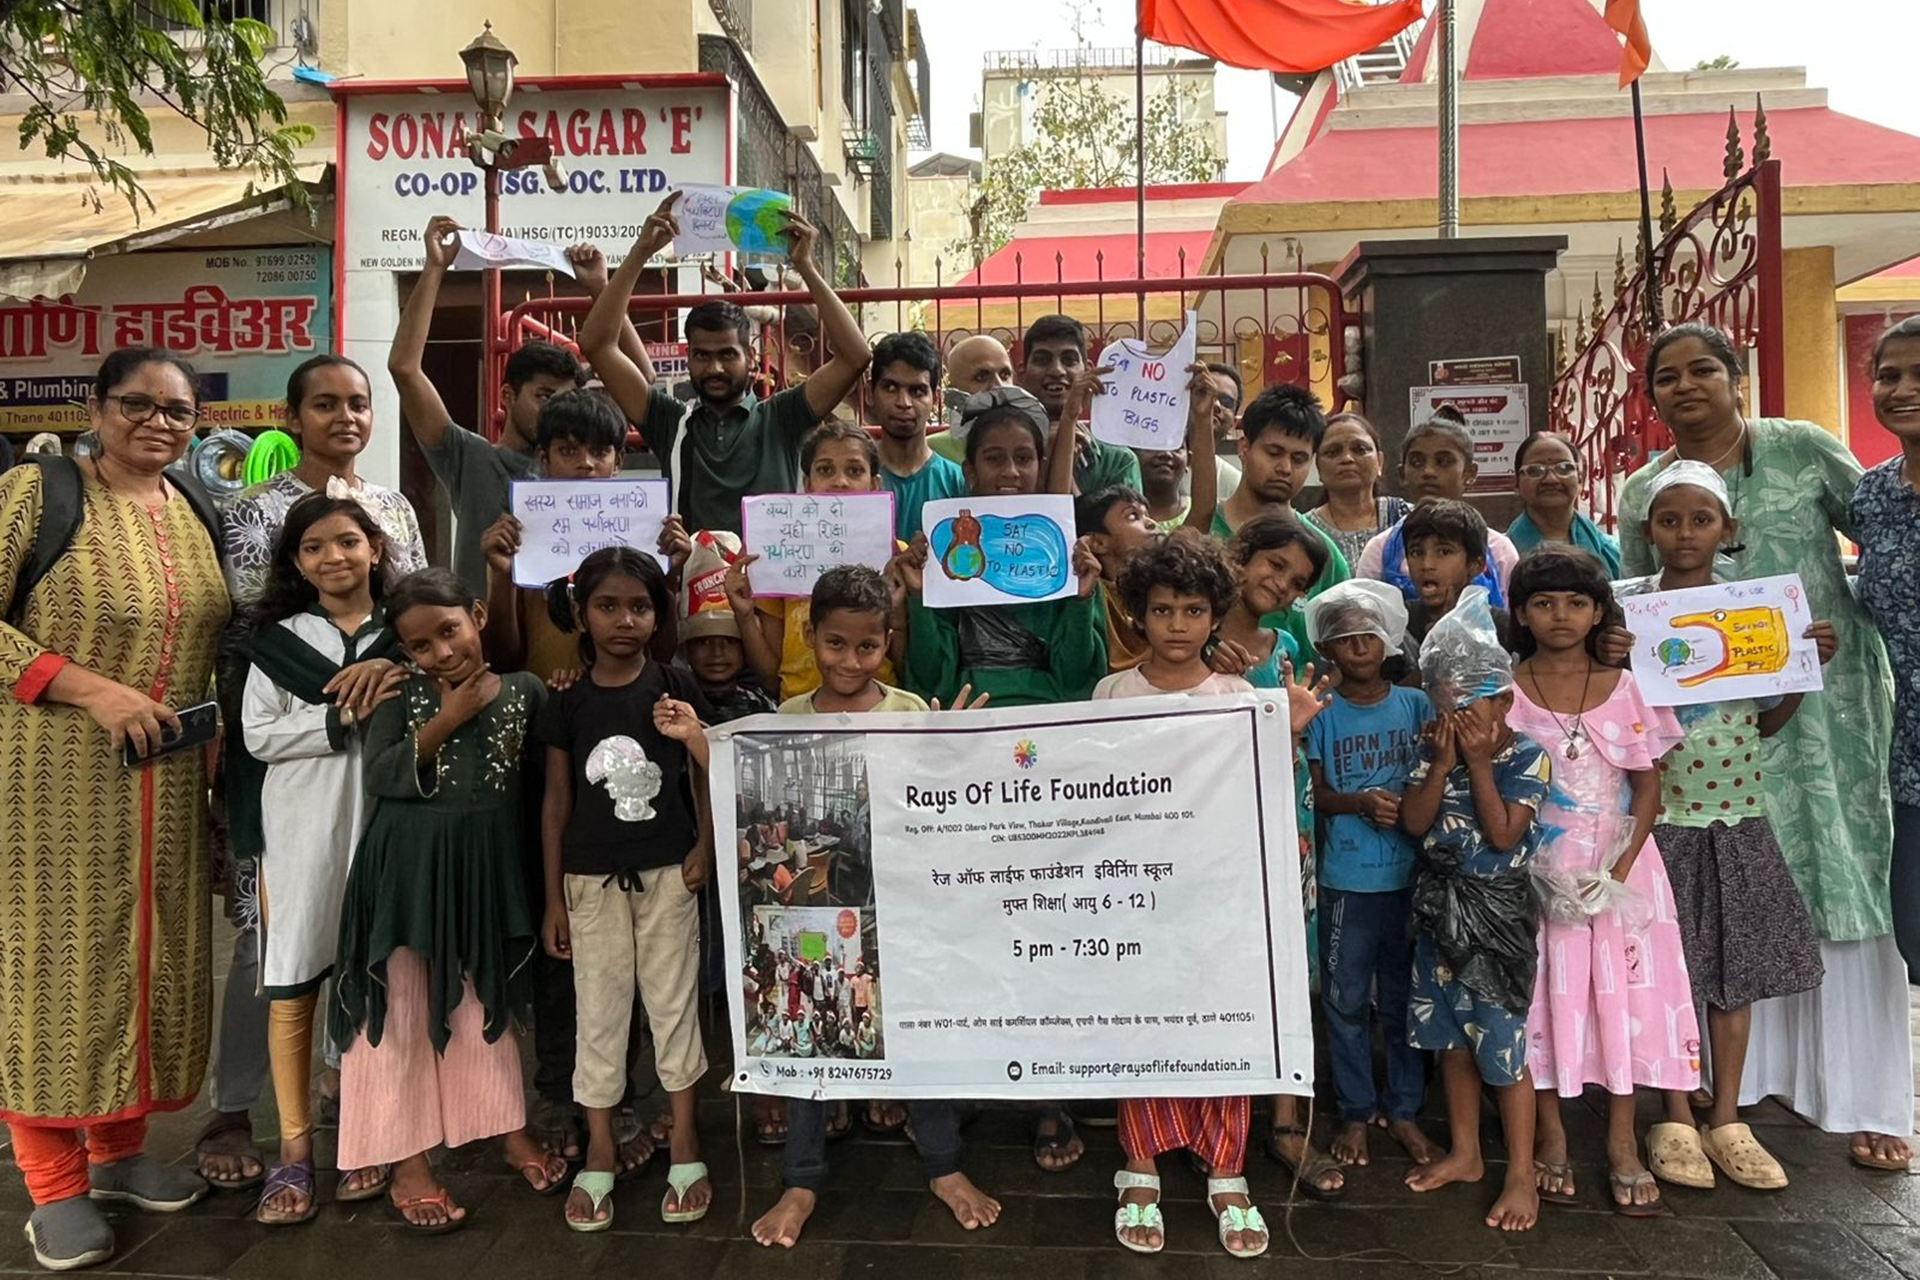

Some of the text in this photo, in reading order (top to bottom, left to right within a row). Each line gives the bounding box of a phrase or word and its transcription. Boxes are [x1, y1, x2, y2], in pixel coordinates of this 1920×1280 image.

[518, 108, 646, 156] SAGAR
[395, 171, 477, 196] CO-OP
[619, 168, 672, 192] LTD.
[382, 229, 421, 241] REGN.
[206, 257, 229, 268] MOB
[256, 255, 285, 266] 97699
[361, 259, 377, 267] NEW
[380, 257, 413, 267] GOLDEN
[288, 270, 317, 281] 00750
[1142, 362, 1165, 381] NO
[1131, 386, 1177, 406] PLASTIC
[6, 411, 44, 423] Thane
[202, 404, 250, 421] Electric
[255, 404, 263, 419] &
[1123, 409, 1159, 432] BAGS
[1004, 523, 1027, 538] SAY
[1004, 543, 1025, 556] NO
[988, 560, 1059, 578] TO PLASTIC
[1731, 645, 1774, 658] PLASTIC
[1334, 733, 1379, 757] BORN
[1334, 756, 1352, 775] BE
[906, 772, 1172, 813] Rays Of Life Foundation
[989, 821, 1006, 830] Park
[932, 869, 951, 886] रेज
[957, 868, 985, 885] ऑफ
[990, 865, 1025, 884] लाईफ
[1030, 862, 1084, 881] फाउंडेशन
[1143, 862, 1173, 882] स्कूल
[1003, 898, 1028, 915] मुफ्त
[1072, 896, 1098, 914] आयु
[1102, 894, 1111, 909] 6
[1129, 893, 1146, 908] 12
[1013, 940, 1022, 957] 5
[1029, 942, 1053, 962] pm
[1073, 938, 1109, 957] 7:30
[1116, 942, 1141, 961] pm
[776, 1066, 797, 1078] Mob
[828, 1067, 892, 1080] 8247675729
[1032, 1058, 1250, 1077] Email: support@raysoflifefoundation.in
